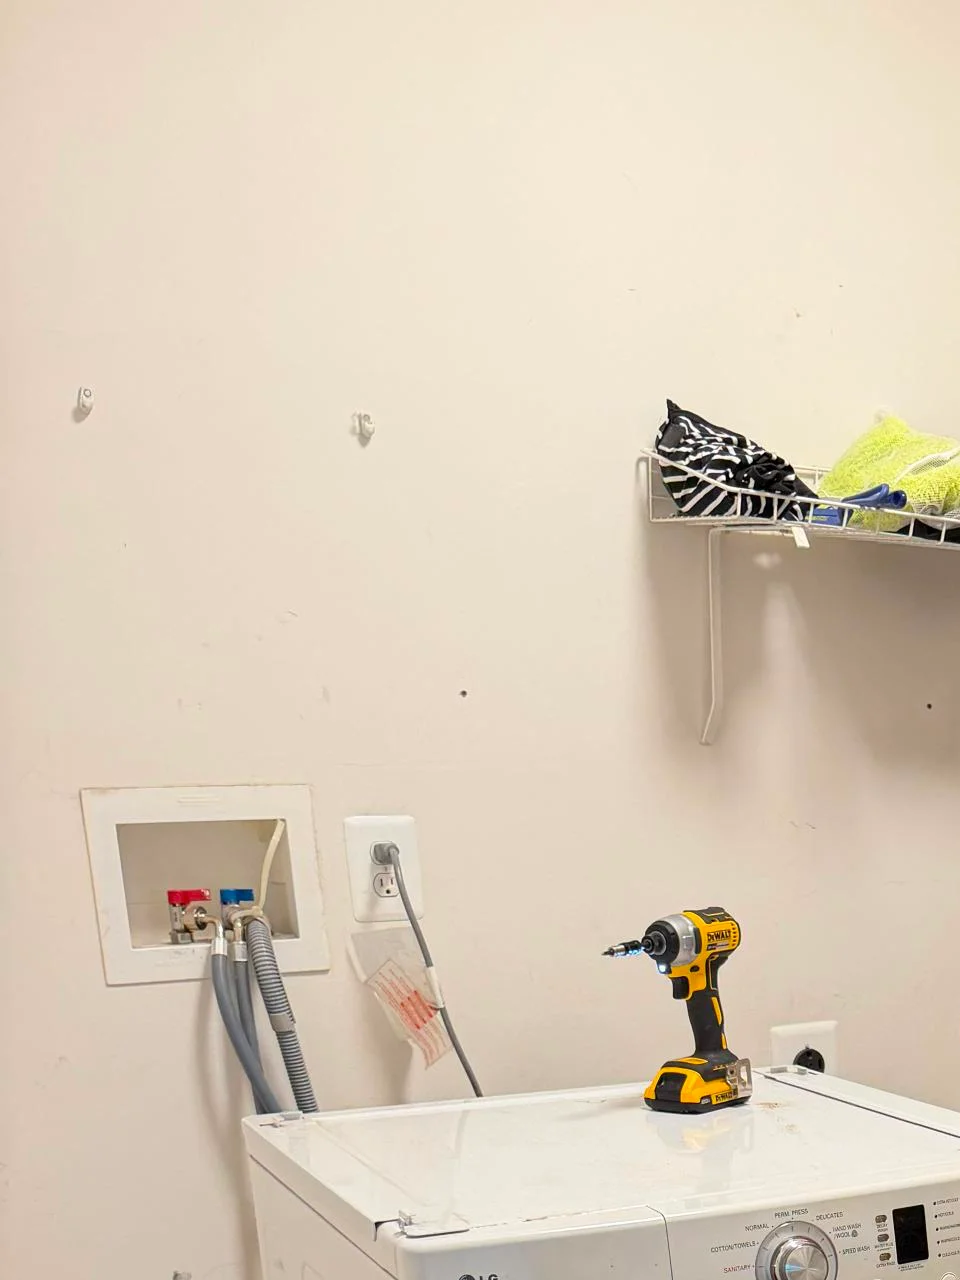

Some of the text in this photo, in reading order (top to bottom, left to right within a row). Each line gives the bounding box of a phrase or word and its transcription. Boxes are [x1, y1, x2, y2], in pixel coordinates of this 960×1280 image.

[791, 1208, 809, 1217] PRESS
[815, 1211, 844, 1221] DELICATES
[744, 1223, 770, 1232] NORMAL
[842, 1247, 857, 1255] SPEED
[723, 1265, 751, 1274] SANITARY
